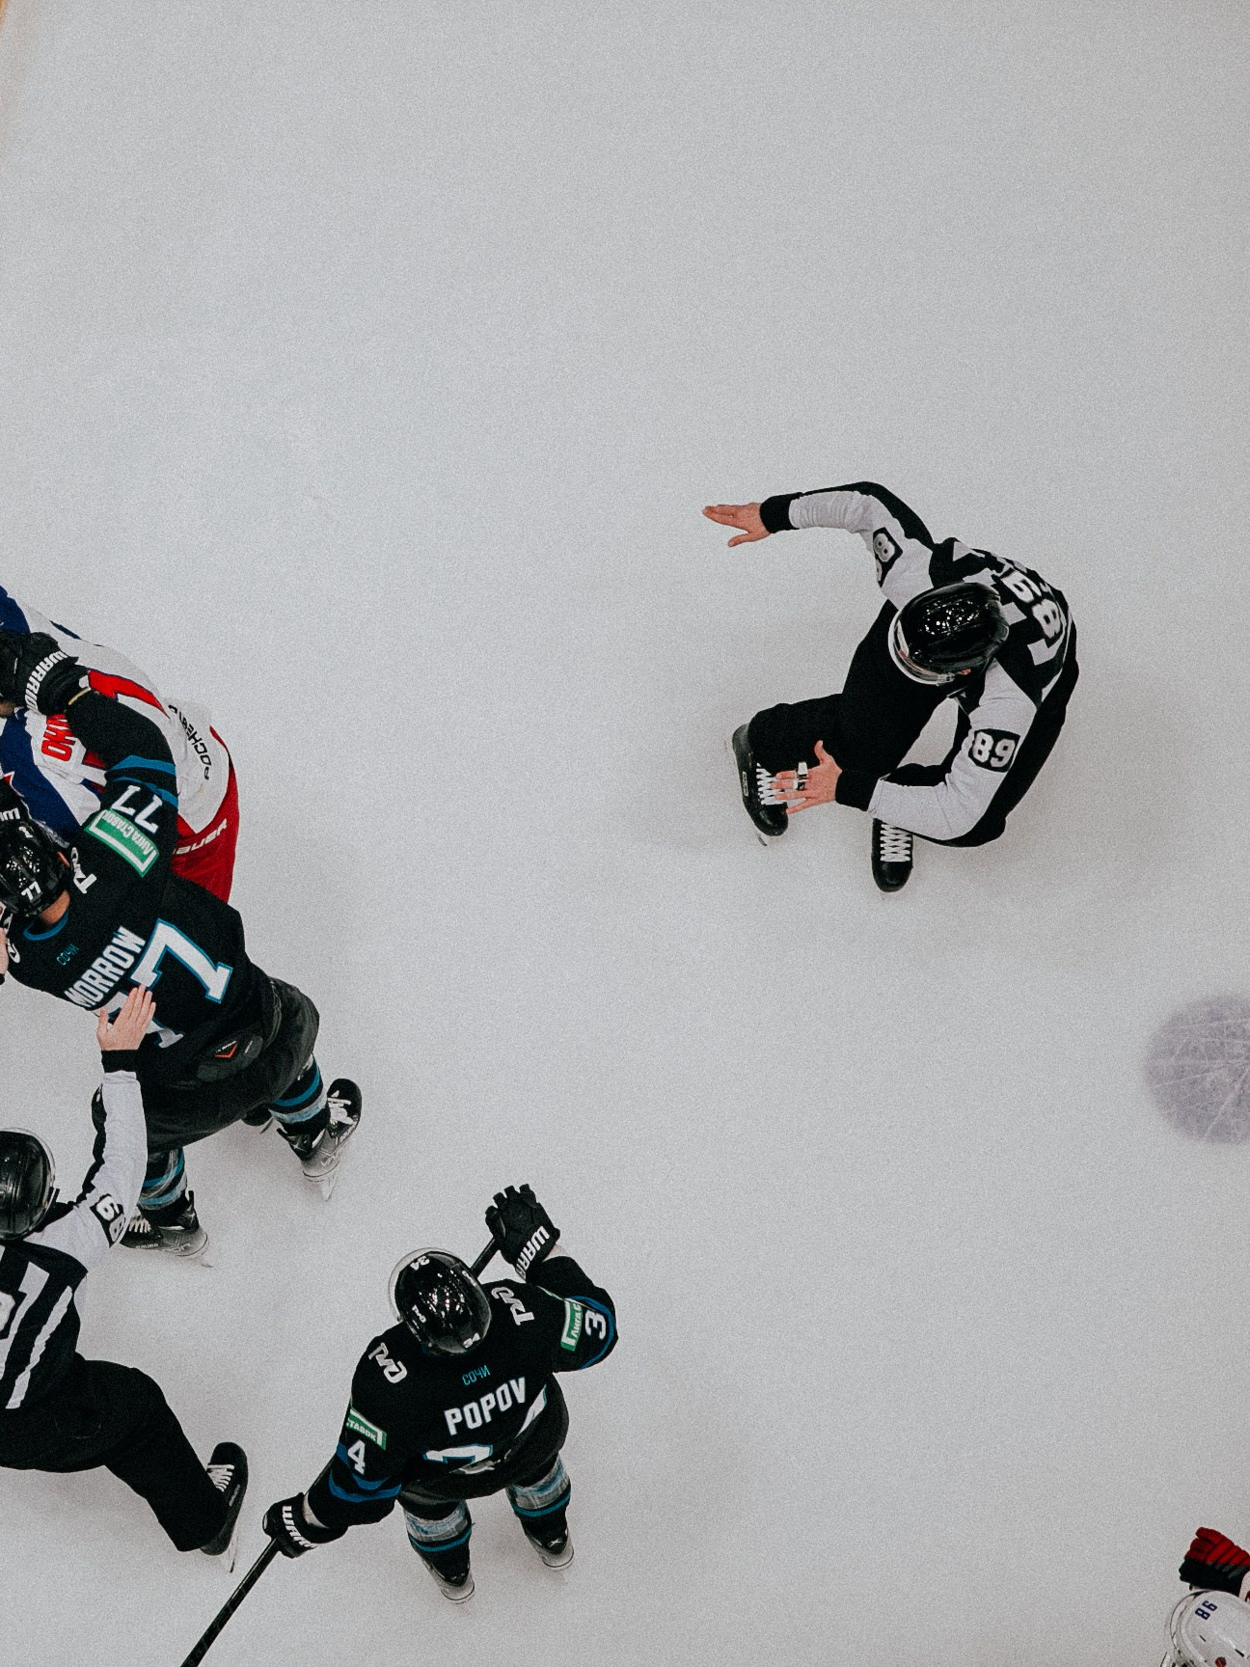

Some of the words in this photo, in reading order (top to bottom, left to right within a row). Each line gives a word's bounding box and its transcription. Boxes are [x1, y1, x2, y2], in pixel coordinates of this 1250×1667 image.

[971, 730, 1016, 769] 89
[111, 785, 163, 835] 77
[21, 881, 44, 900] 77
[64, 927, 147, 1010] MORROW
[584, 1312, 607, 1340] 3
[462, 1365, 490, 1386] СОЧИ
[444, 1377, 526, 1436] POPOV
[347, 1440, 367, 1476] 4
